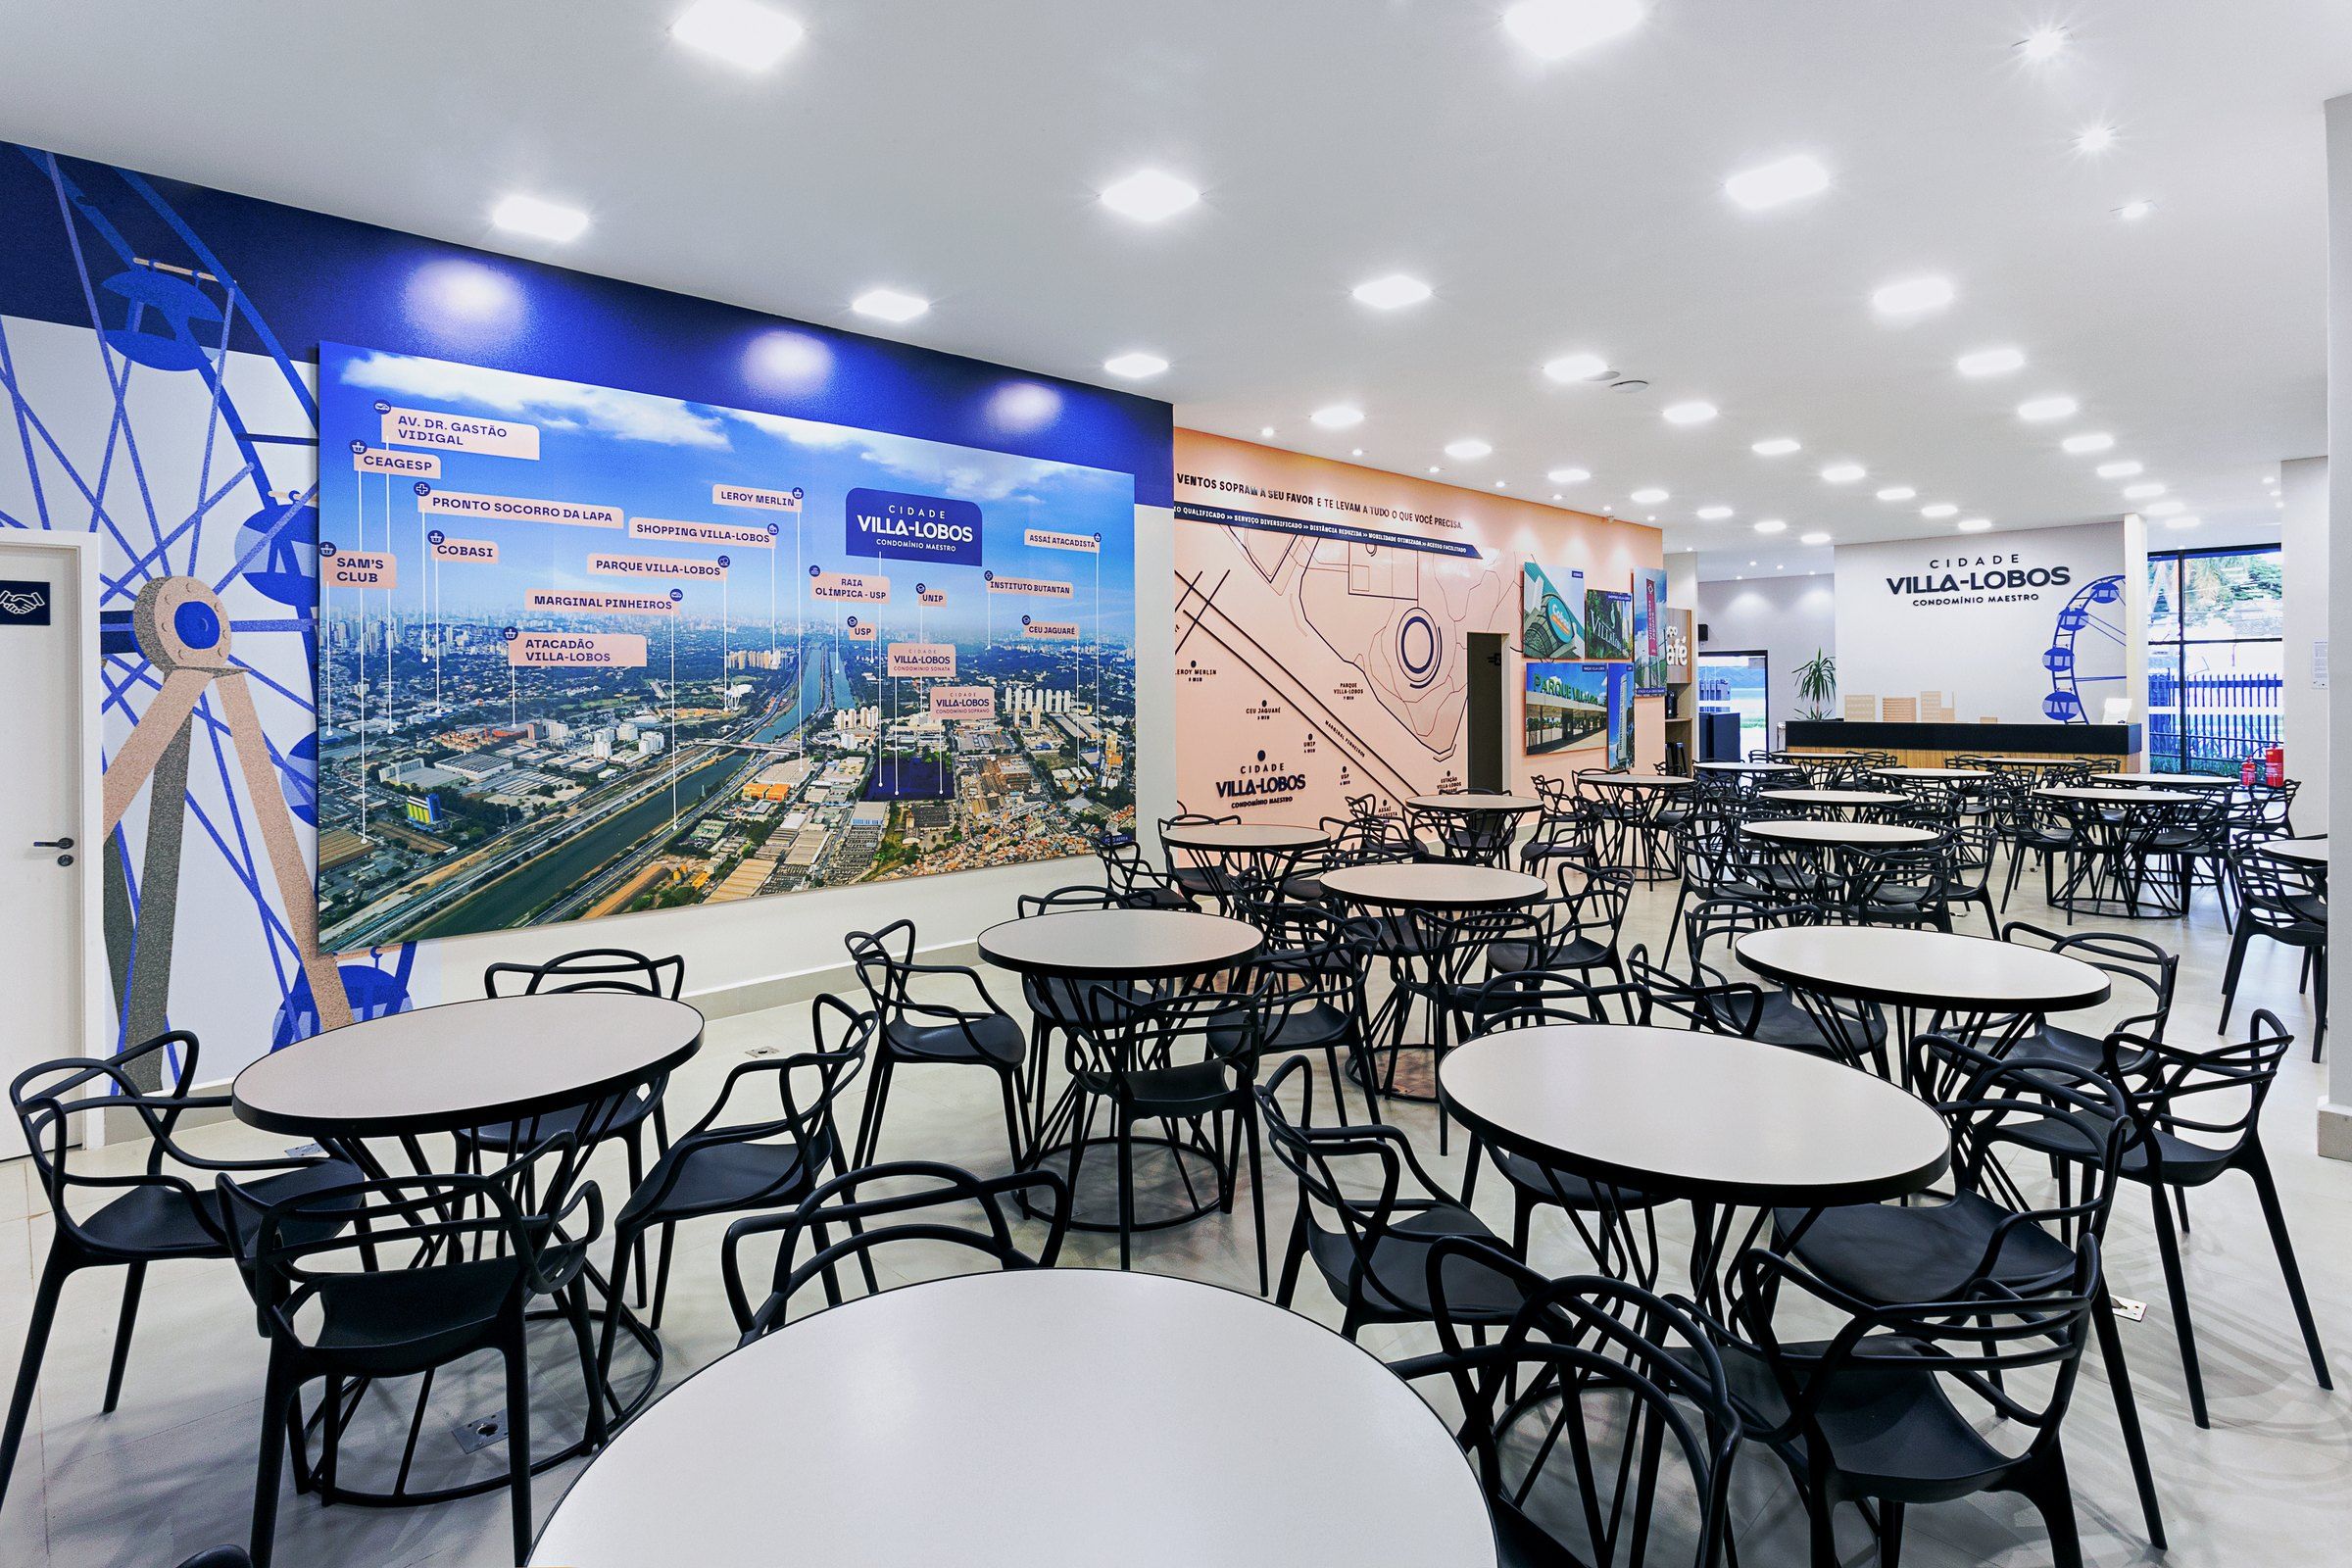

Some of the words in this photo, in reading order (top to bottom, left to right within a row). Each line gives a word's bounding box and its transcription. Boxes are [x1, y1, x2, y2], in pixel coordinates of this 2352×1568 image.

[398, 416, 420, 427] AV.
[424, 418, 448, 430] DR.
[452, 422, 508, 438] GASTÃO
[398, 429, 464, 446] VIDIGAL
[364, 455, 432, 471] CEAGESP
[721, 491, 754, 503] LEROY
[756, 494, 795, 507] MERLIN
[1176, 472, 1217, 489] VENTOS
[1219, 481, 1258, 496] SOPRAM
[1260, 489, 1266, 498] A
[1268, 490, 1284, 501] SEU
[1286, 493, 1314, 506] FAVOR
[1317, 497, 1322, 507] E
[1324, 498, 1334, 509] TE
[1336, 500, 1361, 513] LEVAM
[1363, 505, 1368, 514] A
[1369, 506, 1390, 517] TUDO
[1392, 510, 1397, 519] O
[1398, 511, 1413, 522] QUE
[1414, 514, 1433, 525] VOCÊ
[433, 497, 491, 512] PRONTO
[494, 503, 561, 517] SOCORRO
[564, 509, 580, 519] DA
[583, 511, 612, 522] LAPA
[888, 504, 946, 519] CIDADE
[637, 523, 698, 537] SHOPPING
[700, 529, 770, 543] VILLA-LOBOS
[857, 514, 973, 543] VILLA-LOBOS
[1183, 507, 1226, 519] QUALIFICADO
[1234, 514, 1259, 524] SERVIÇO
[1260, 517, 1302, 529] DIVERSIFICADO
[1309, 524, 1338, 534] DISTÂNCIA
[1339, 528, 1363, 537] REDUZIDA
[1368, 533, 1396, 543] MOBILIDADE
[1397, 537, 1421, 546] OTIMIZADA
[1427, 541, 1443, 550] ACESSO
[876, 538, 924, 549] CONDOMÍNIO
[925, 543, 956, 552] MAESTRO
[1029, 534, 1051, 544] ASSAÍ
[1052, 537, 1095, 548] ATACADISTA
[437, 545, 493, 558] COBASI
[336, 558, 384, 569] SAM'S
[596, 560, 643, 572] PARQUE
[645, 563, 720, 576] VILLA-LOBOS
[1930, 554, 2019, 569] CIDADE
[336, 571, 378, 583] CLUB
[841, 578, 863, 587] RAIA
[1886, 566, 2071, 595] VILLA-LOBOS
[815, 586, 863, 597] OLÍMPICA
[869, 591, 886, 600] USP
[990, 581, 1033, 591] INSTITUTO
[1034, 584, 1070, 594] BUTANTAN
[534, 596, 603, 608] MARGINAL
[606, 599, 672, 610] PINHEIROS
[922, 594, 944, 603] UNIP
[1912, 596, 1984, 607] CONDOMÍNIO
[1988, 593, 2039, 603] MAESTRO
[854, 627, 871, 636] USP
[525, 639, 594, 650] ATACADÃO
[1666, 636, 1688, 666] afé
[525, 652, 611, 662] VILLA-LOBOS
[894, 656, 951, 664] VILLA-LOBOS
[936, 699, 990, 708] VILLA-LOBOS
[1241, 762, 1285, 774] CIDADE
[1215, 774, 1306, 798] VILLA-LOBOS
[1231, 798, 1267, 808] CONDOMÍNIO
[1269, 796, 1293, 805] MAESTRO
